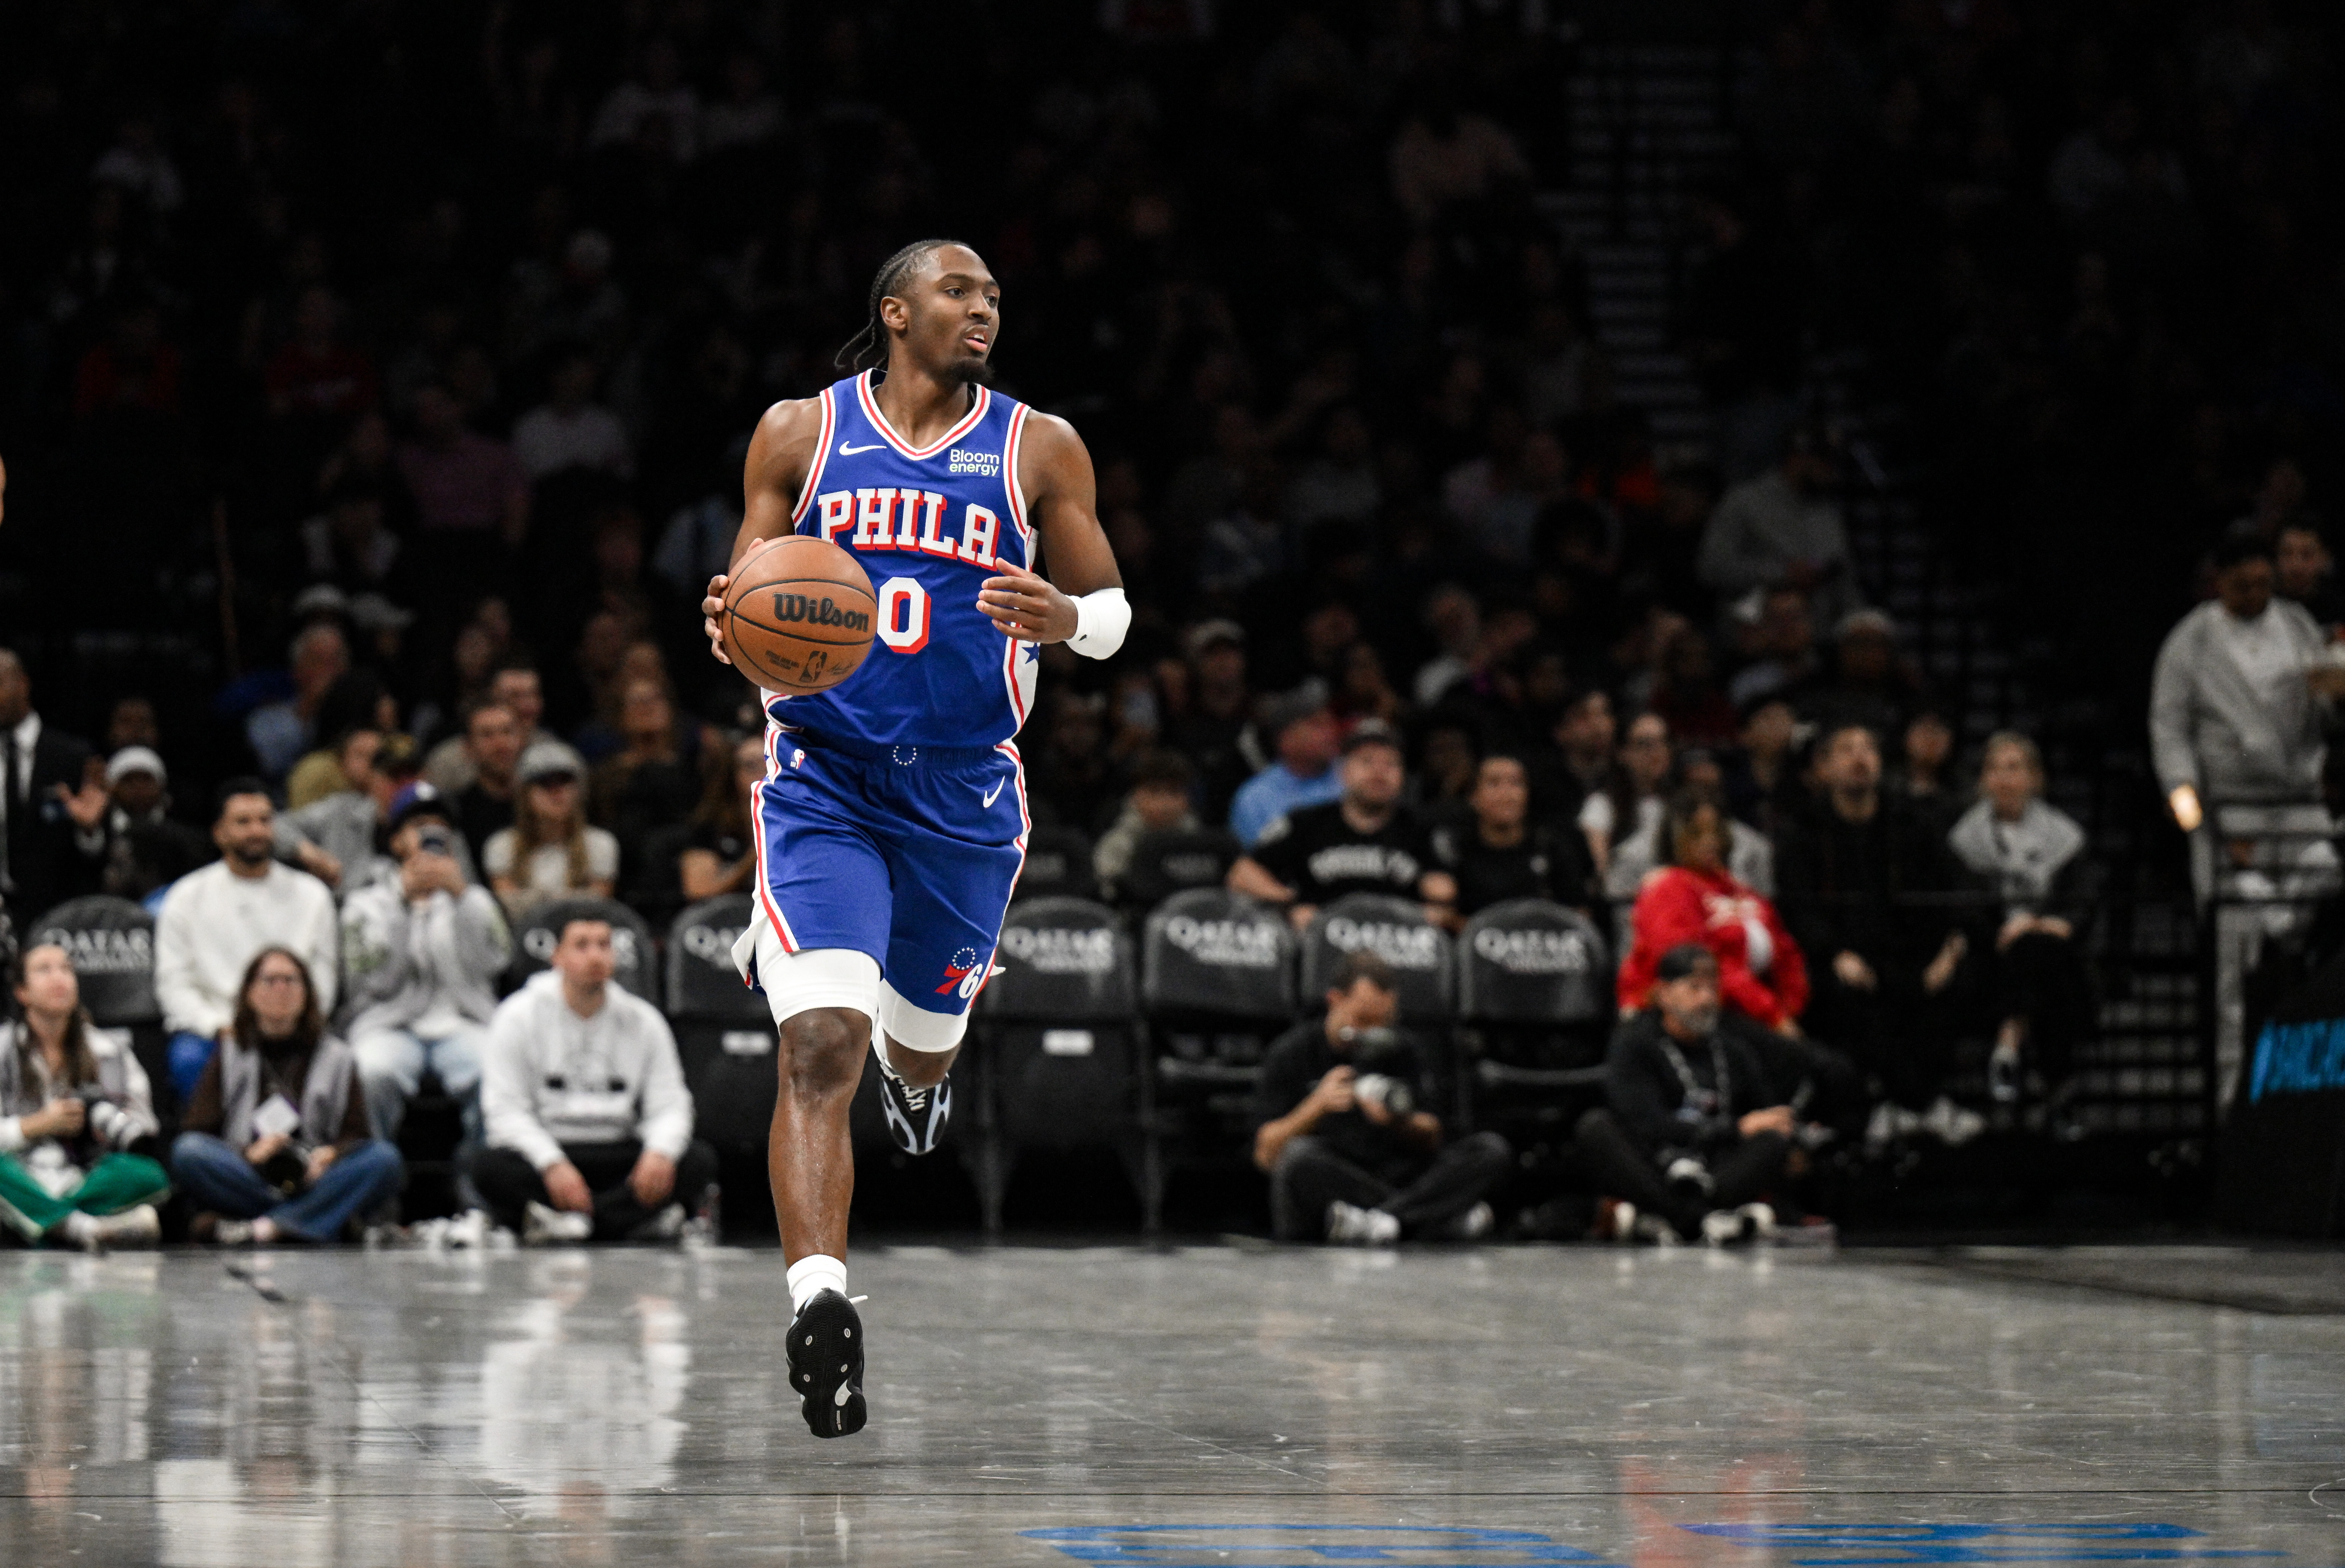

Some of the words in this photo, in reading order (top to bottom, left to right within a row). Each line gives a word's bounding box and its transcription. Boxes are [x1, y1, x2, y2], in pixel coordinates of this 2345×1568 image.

[949, 463, 999, 476] energy
[950, 449, 999, 465] Bloom
[818, 488, 1001, 571] PHILA
[773, 592, 869, 633] Wilson
[877, 577, 931, 654] 0
